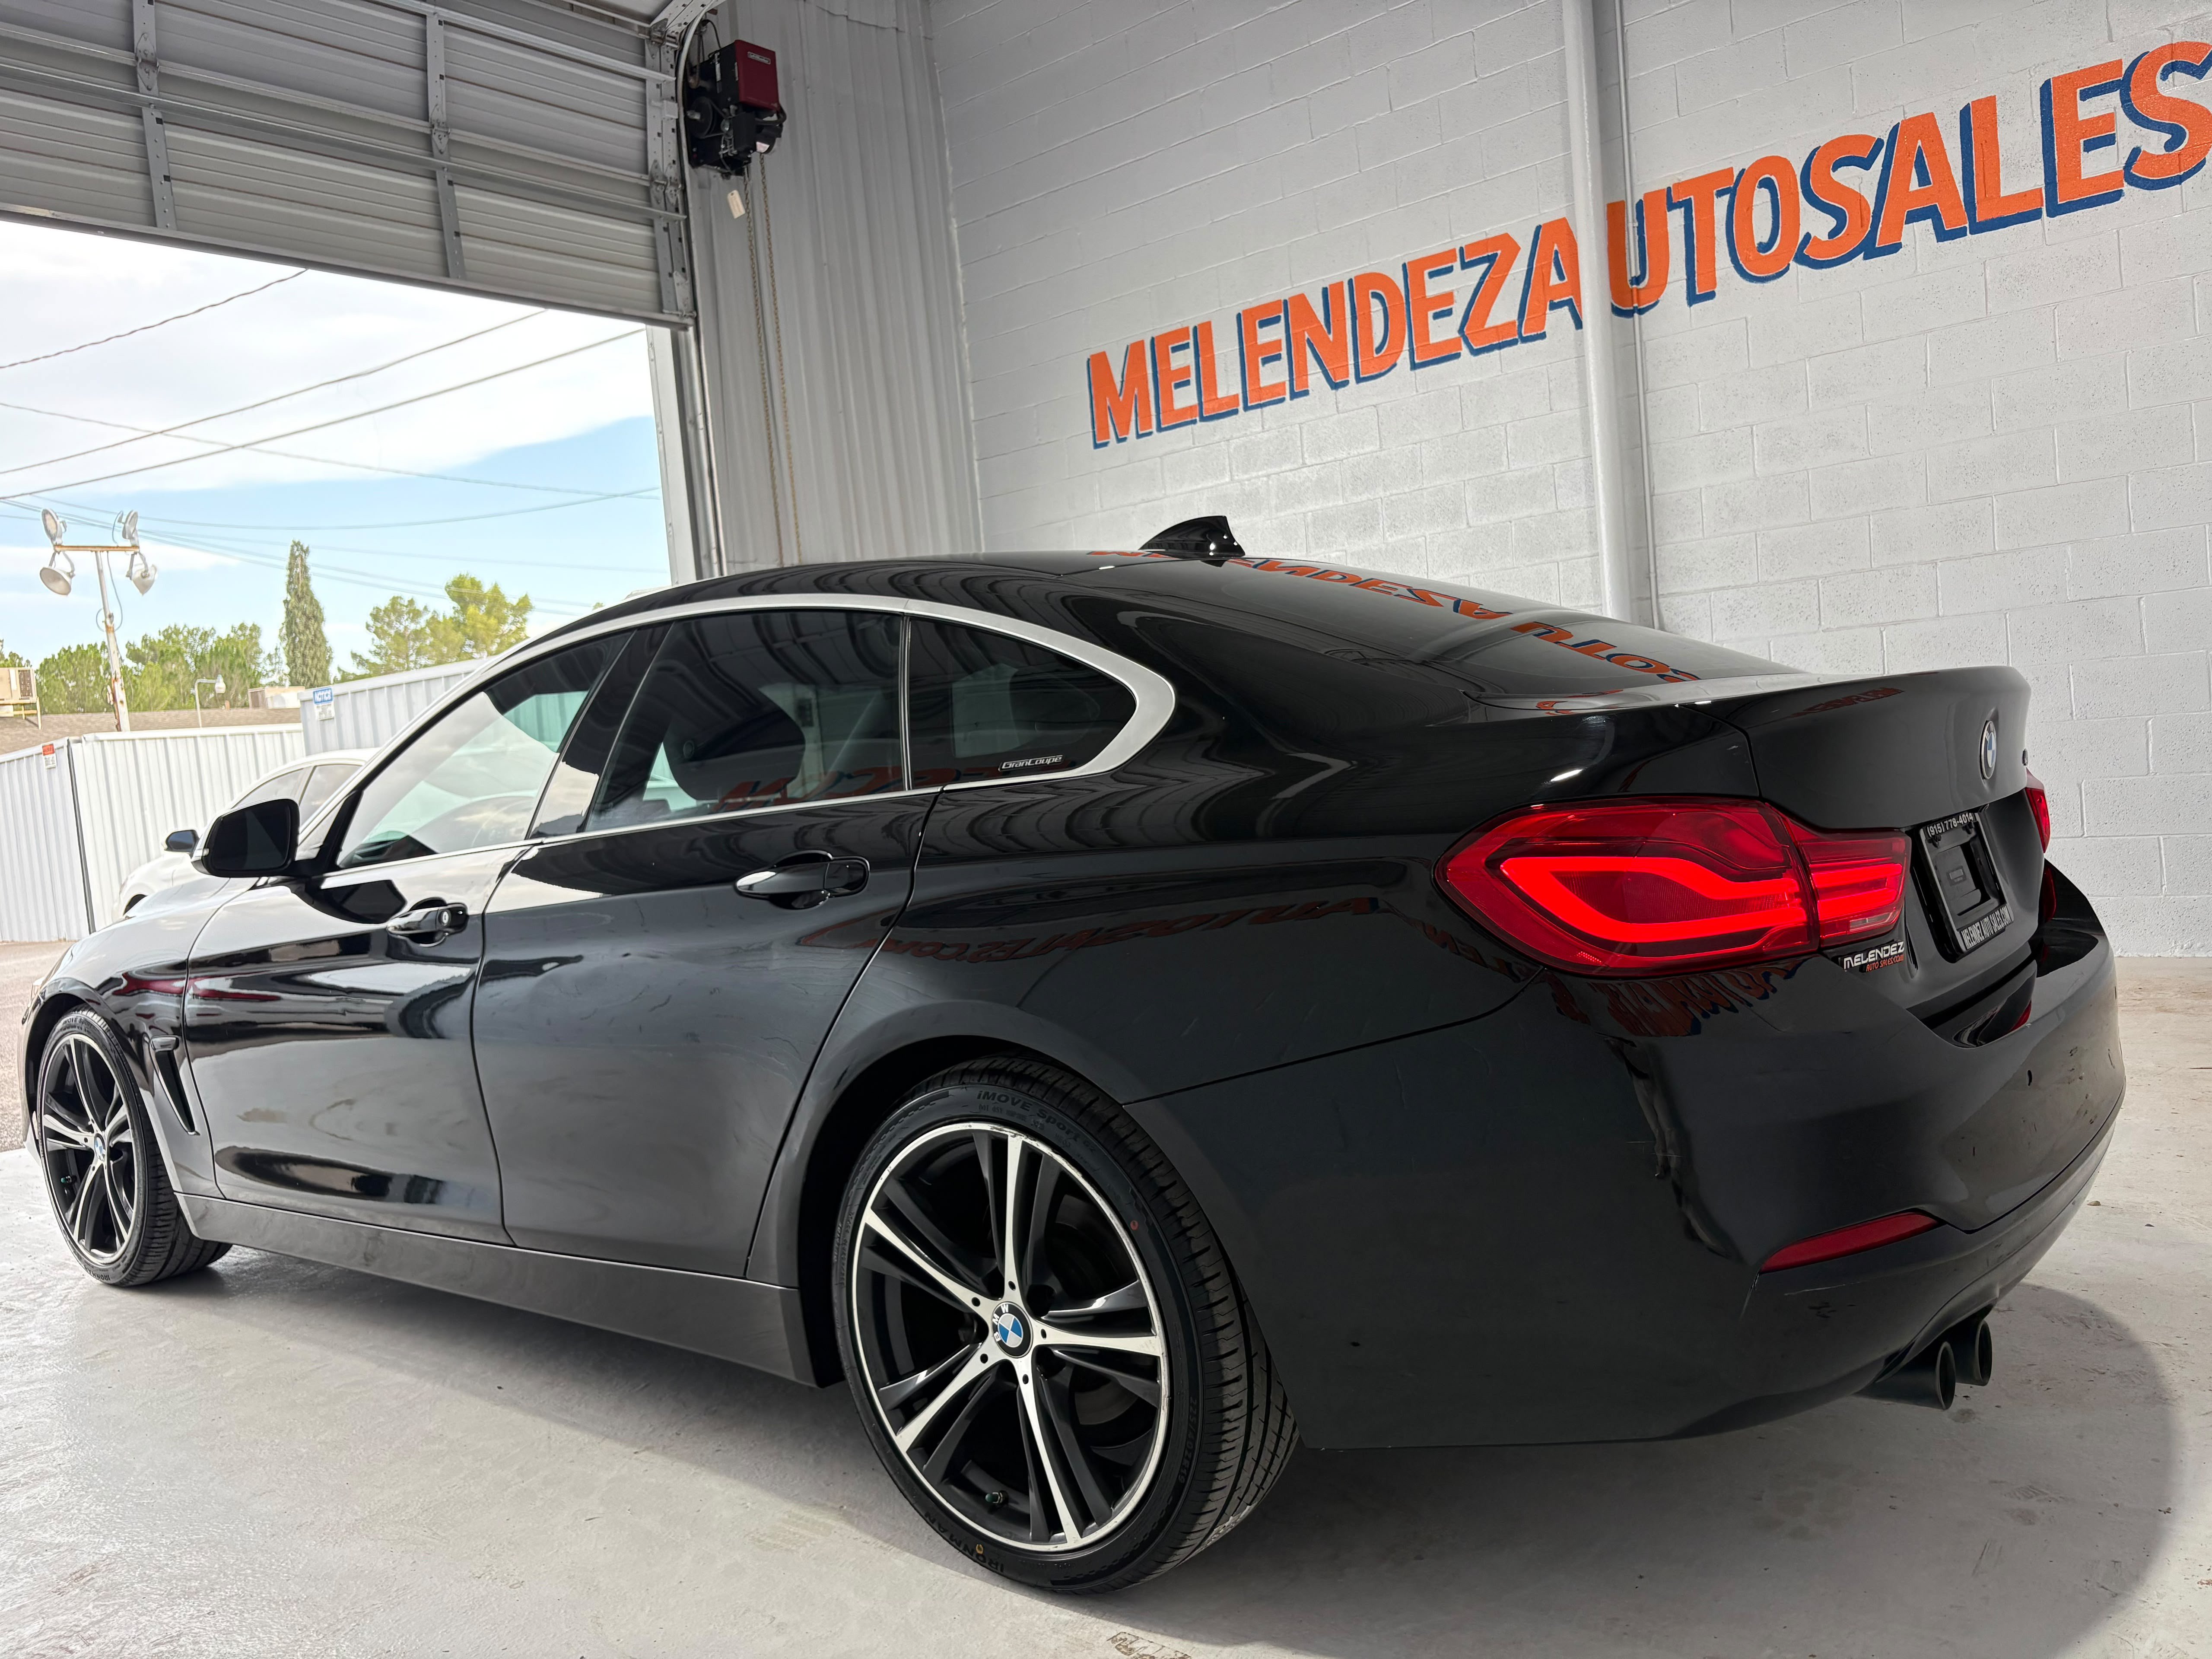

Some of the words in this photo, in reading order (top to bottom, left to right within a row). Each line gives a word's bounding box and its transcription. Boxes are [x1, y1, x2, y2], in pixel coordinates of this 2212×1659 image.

[1843, 941, 1904, 969] MELENDEZ
[1866, 963, 1879, 972] AUTO
[976, 1090, 1033, 1112] iMOVE
[925, 1511, 1005, 1573] IRONMAN
